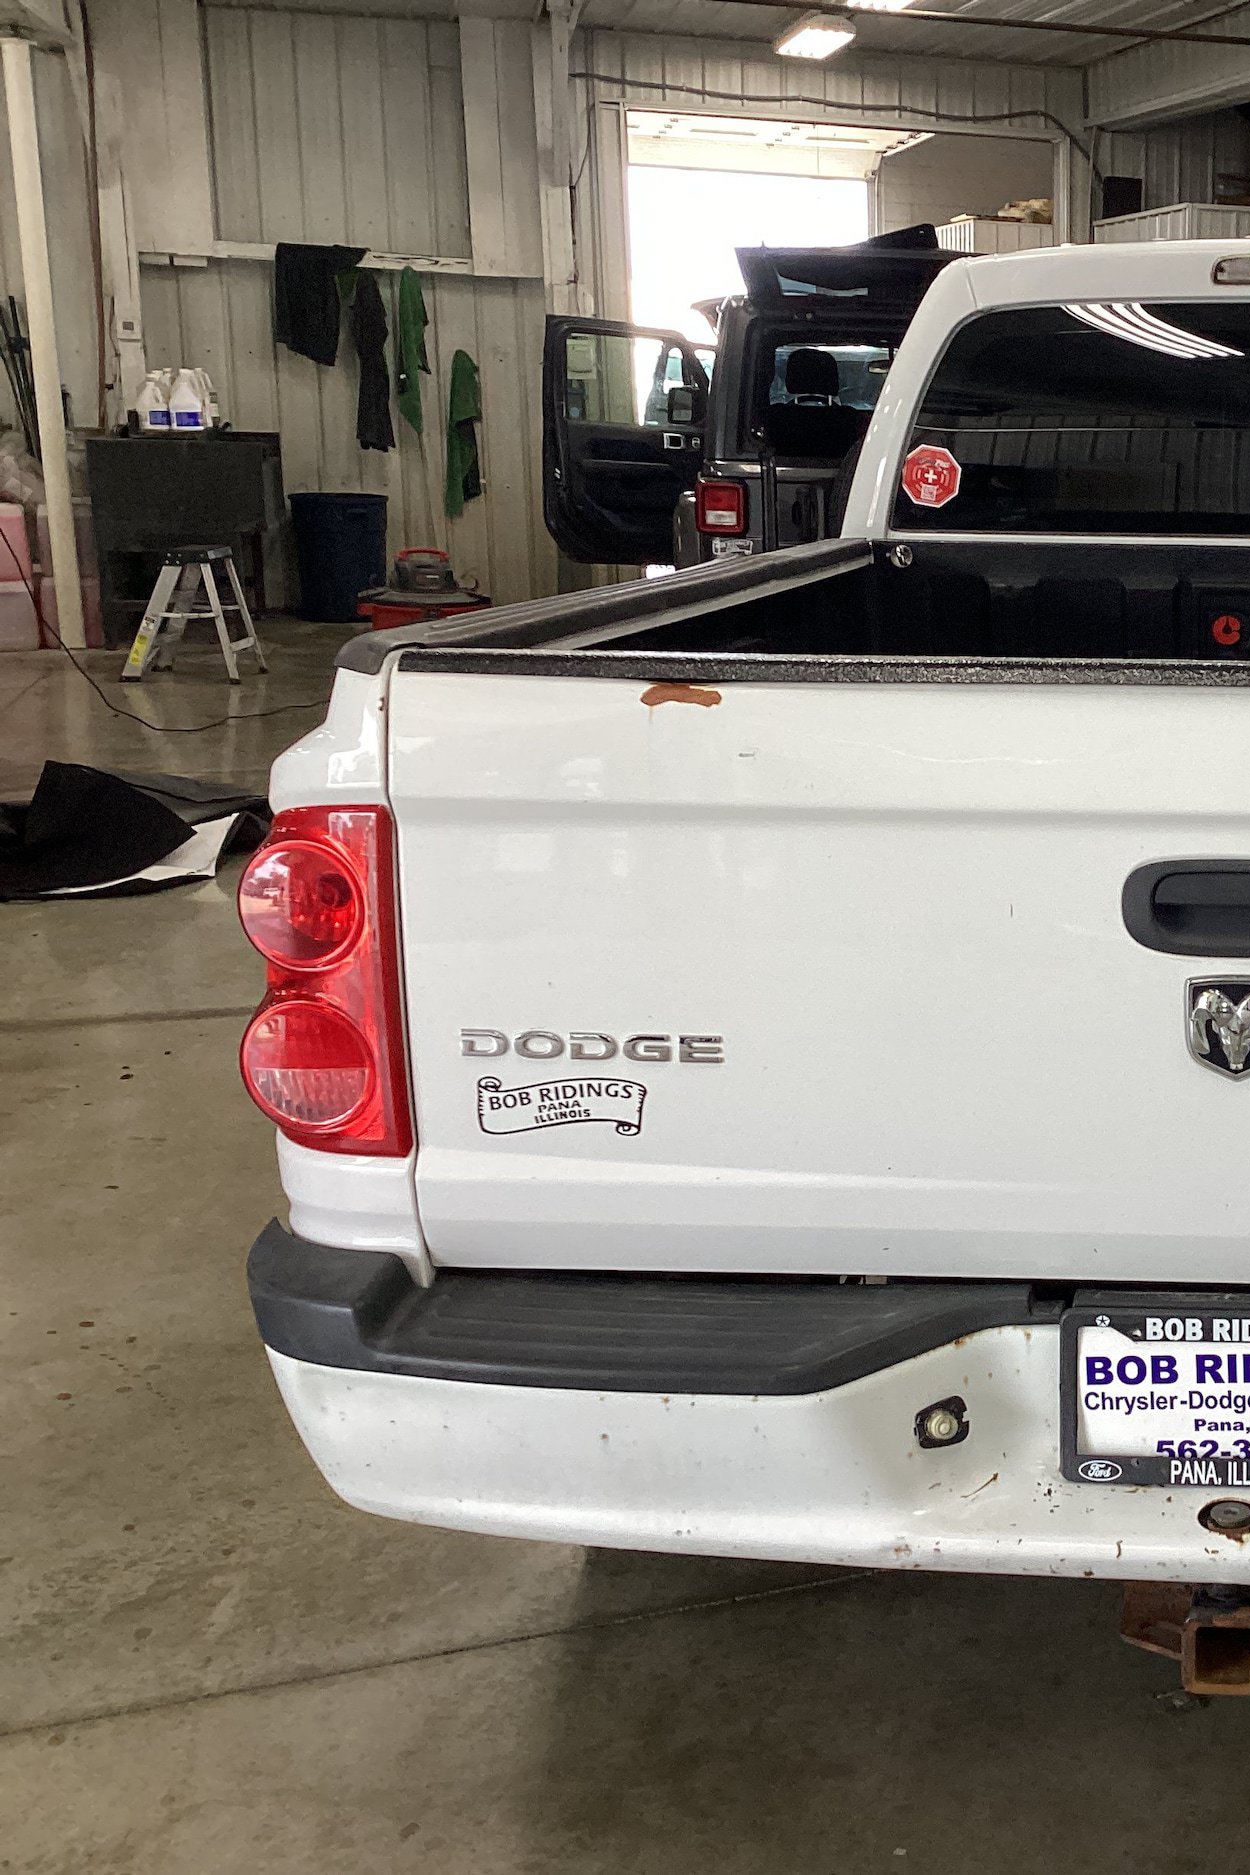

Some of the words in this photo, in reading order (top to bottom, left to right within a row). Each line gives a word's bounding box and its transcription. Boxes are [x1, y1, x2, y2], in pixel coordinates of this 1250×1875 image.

[460, 1028, 725, 1063] DODGE
[488, 1091, 532, 1111] BOB
[539, 1083, 634, 1103] RIDINGS
[538, 1100, 582, 1113] PANA
[534, 1109, 591, 1124] ILLINOIS
[1145, 1317, 1204, 1342] BOB
[1085, 1355, 1179, 1386] BOB
[1194, 1418, 1250, 1434] Pana,
[1088, 1463, 1111, 1477] Ford
[1170, 1460, 1222, 1485] PANA,
